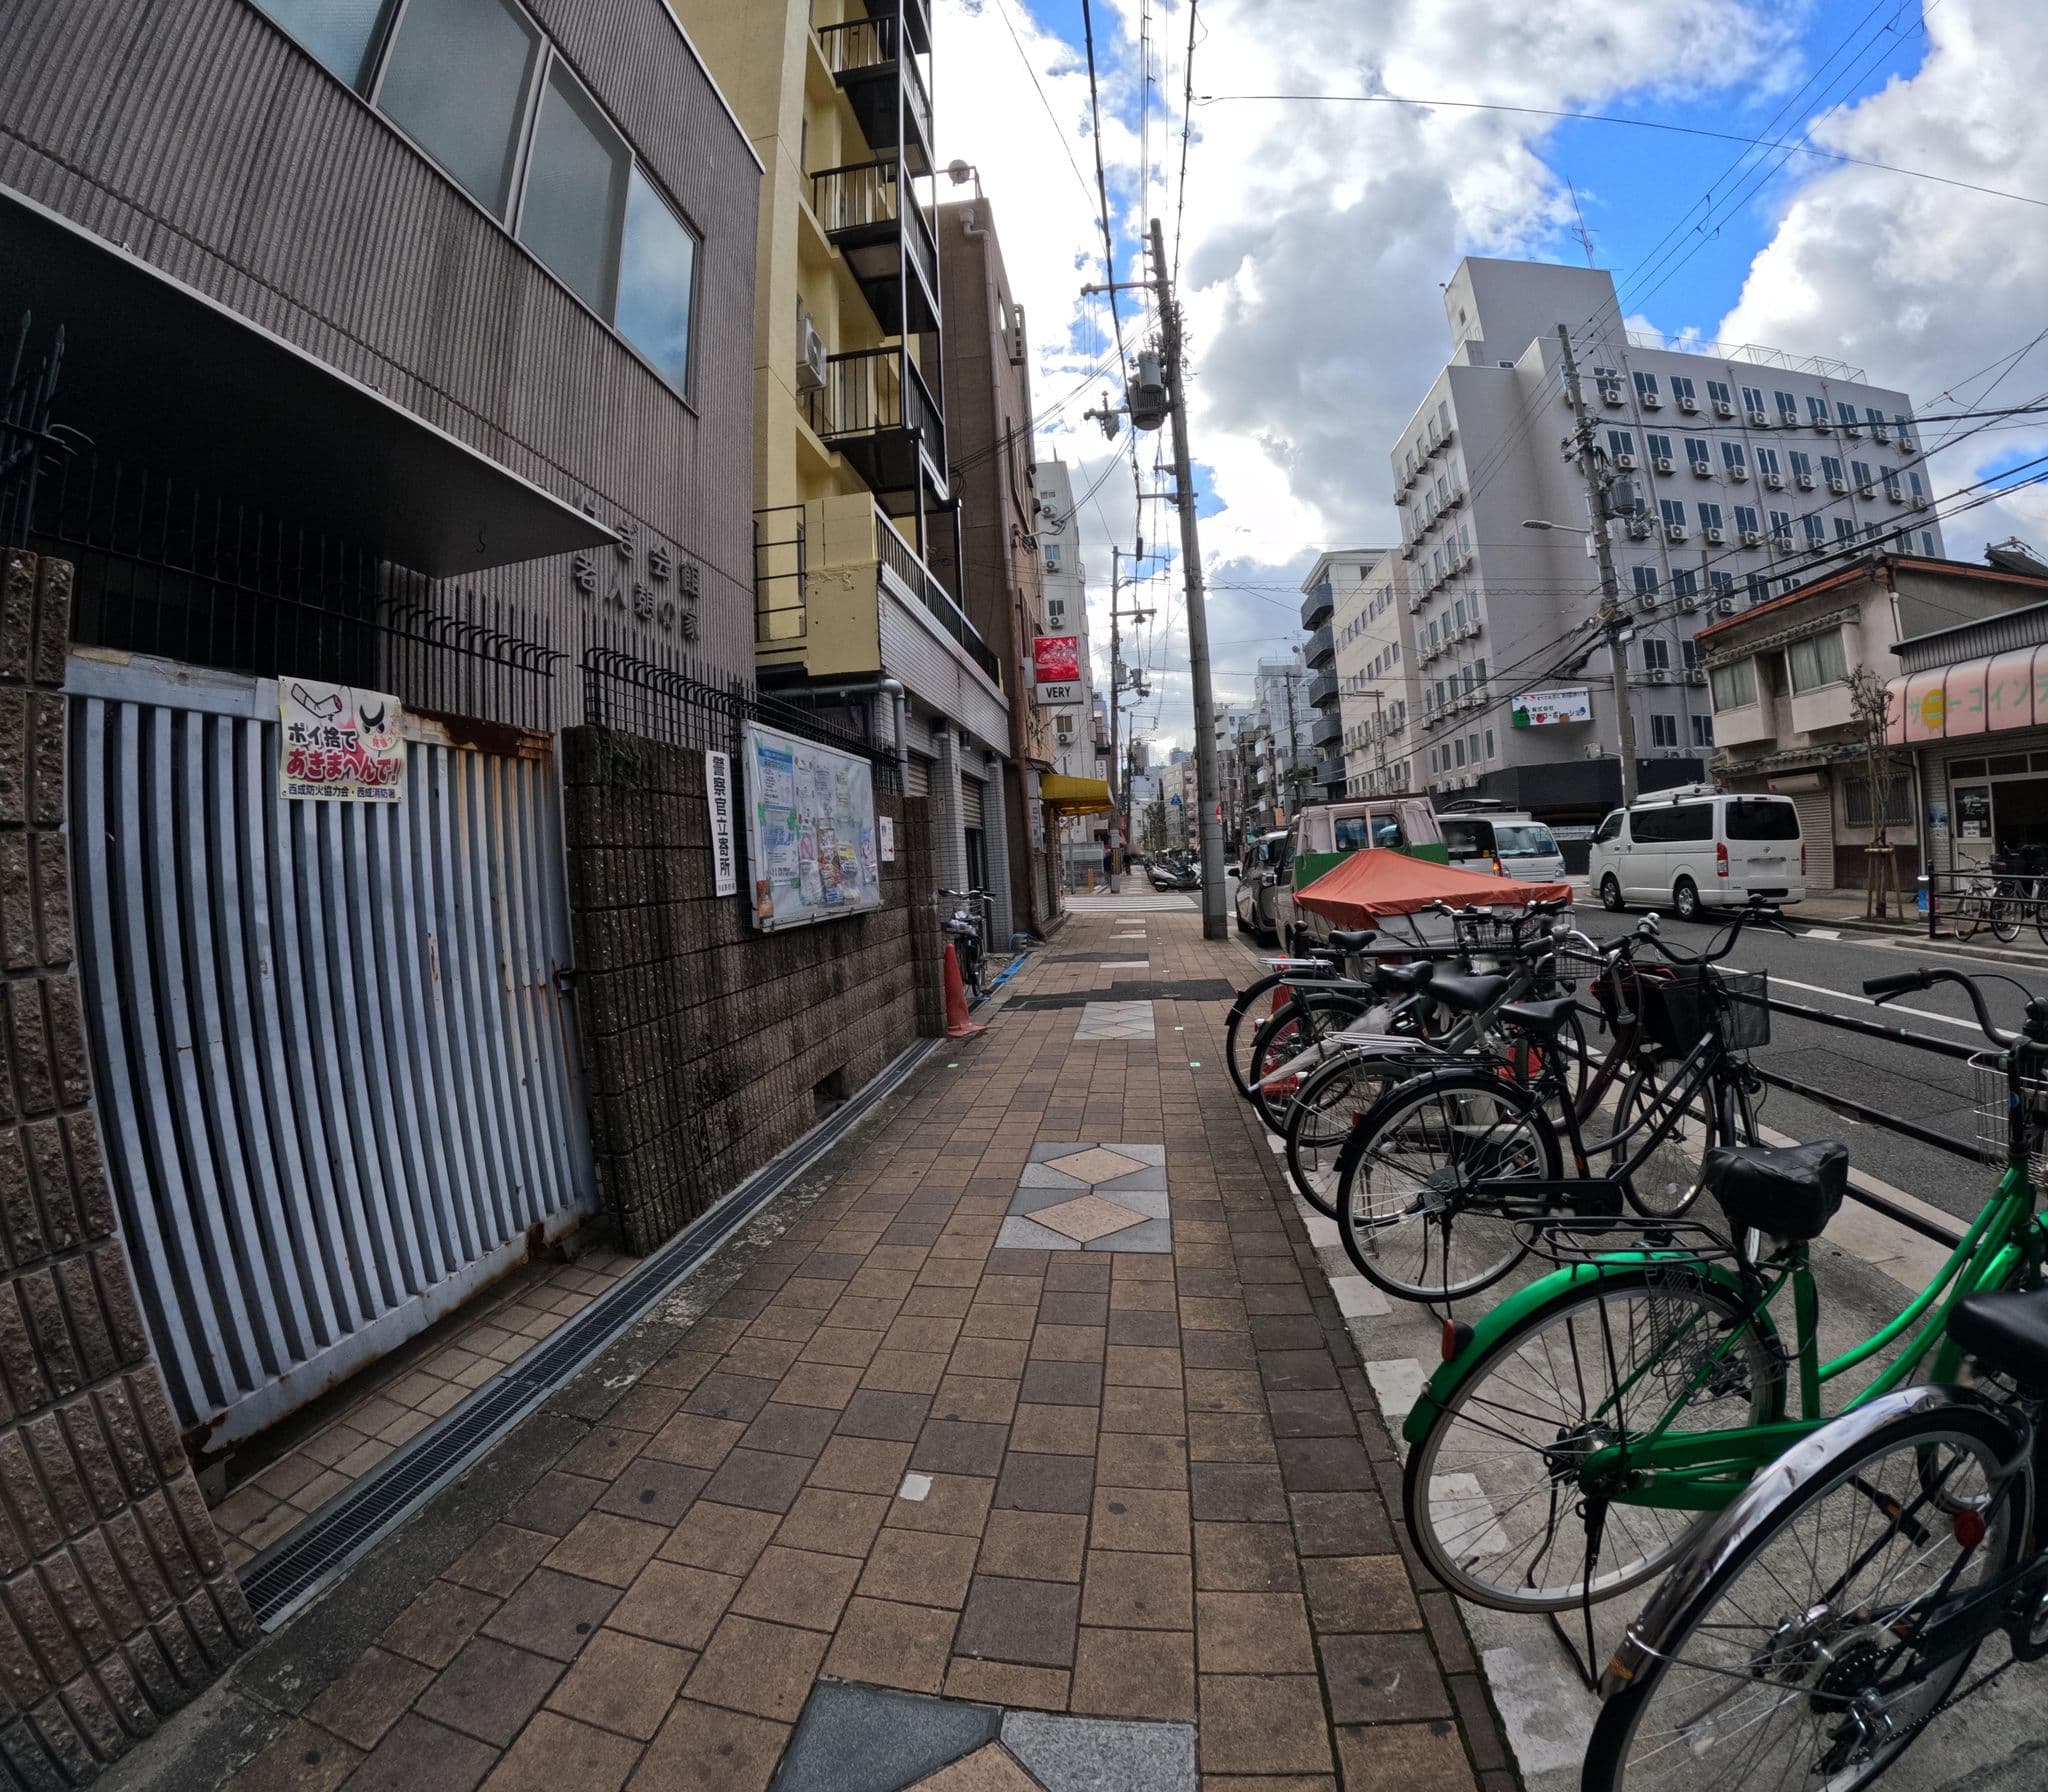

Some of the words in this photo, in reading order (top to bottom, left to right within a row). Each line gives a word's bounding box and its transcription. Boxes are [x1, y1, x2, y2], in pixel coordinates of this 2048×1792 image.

[573, 551, 700, 640] 老人憩の家
[1046, 686, 1071, 699] VERY
[288, 722, 357, 749] ポイ捨て
[712, 755, 730, 877] 警察官立寄所
